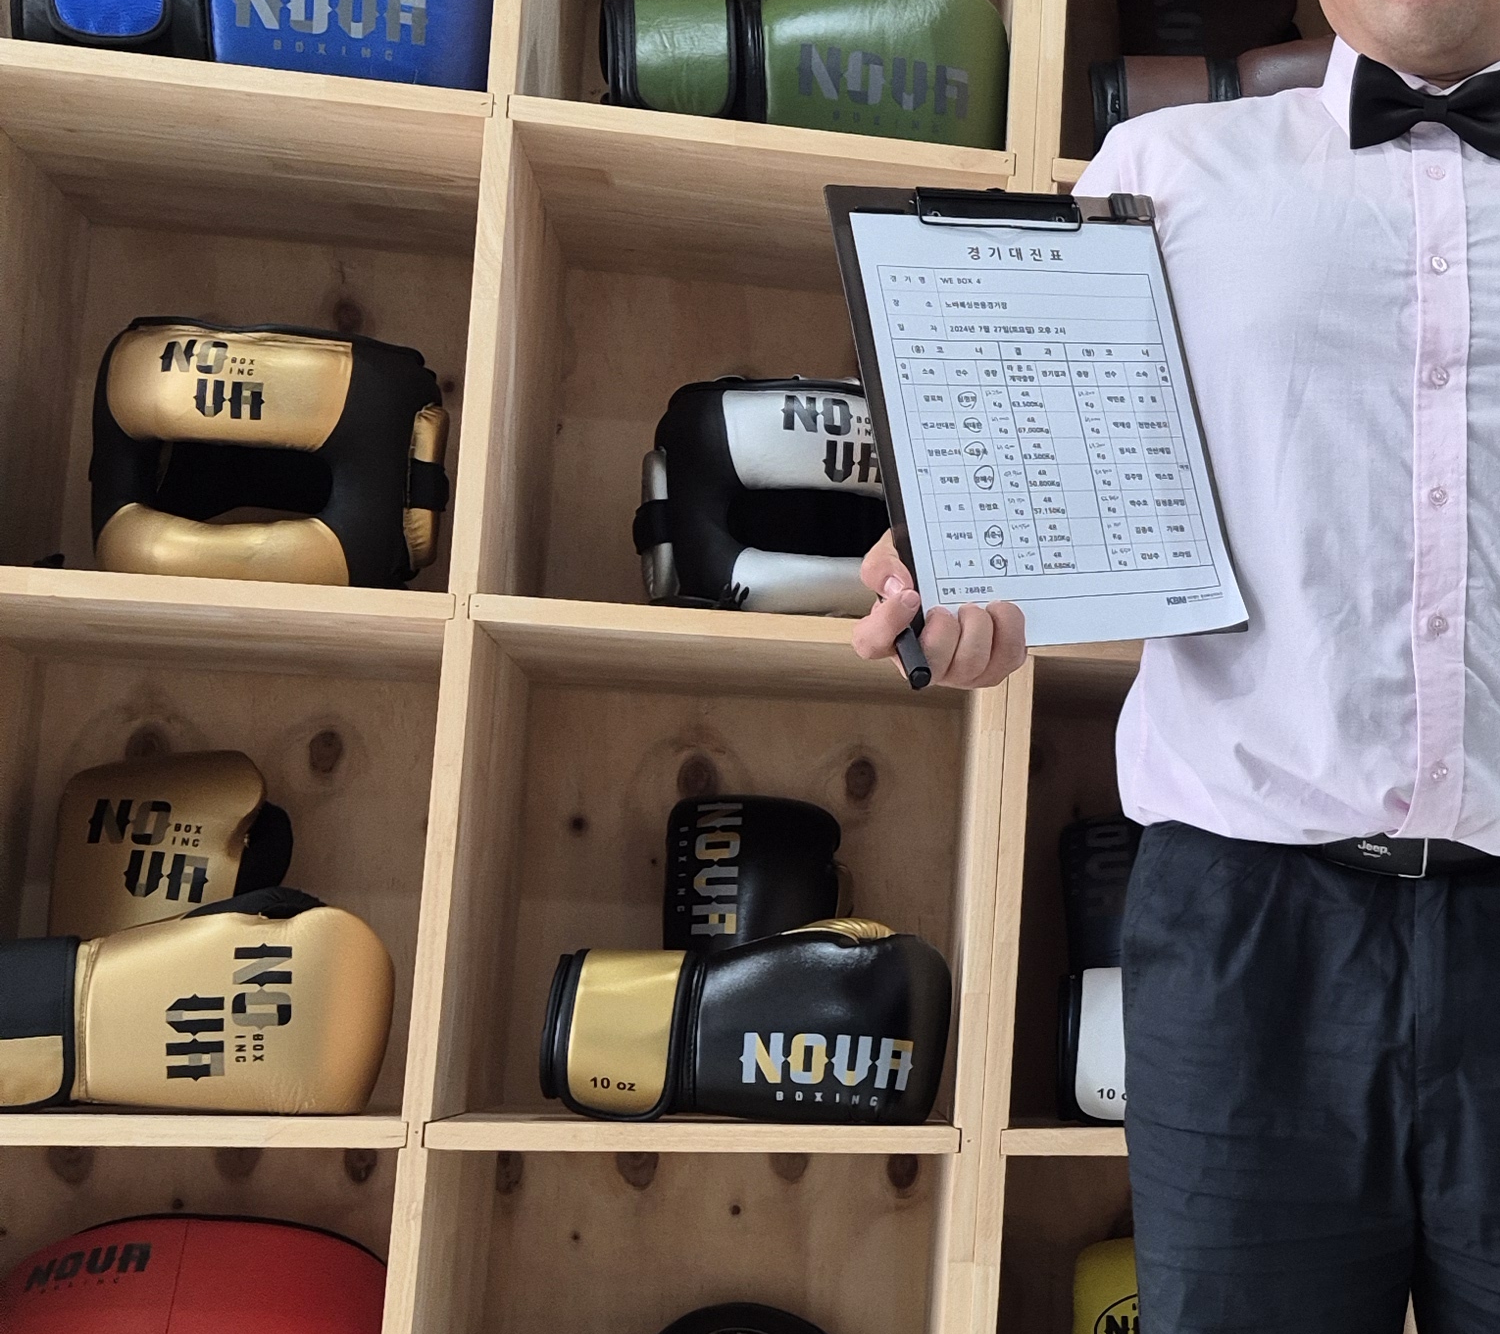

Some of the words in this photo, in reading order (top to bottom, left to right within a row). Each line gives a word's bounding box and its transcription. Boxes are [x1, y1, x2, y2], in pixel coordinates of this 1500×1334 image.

[272, 38, 394, 62] BOXING
[228, 367, 255, 377] ING
[1166, 595, 1188, 606] KBM
[173, 823, 203, 835] BOX
[172, 837, 201, 848] ING
[234, 1034, 248, 1064] ING
[252, 1033, 266, 1063] BOX
[588, 1076, 612, 1091] 10
[616, 1079, 638, 1092] oz
[775, 1090, 879, 1108] BOXING
[1096, 1088, 1117, 1101] 10
